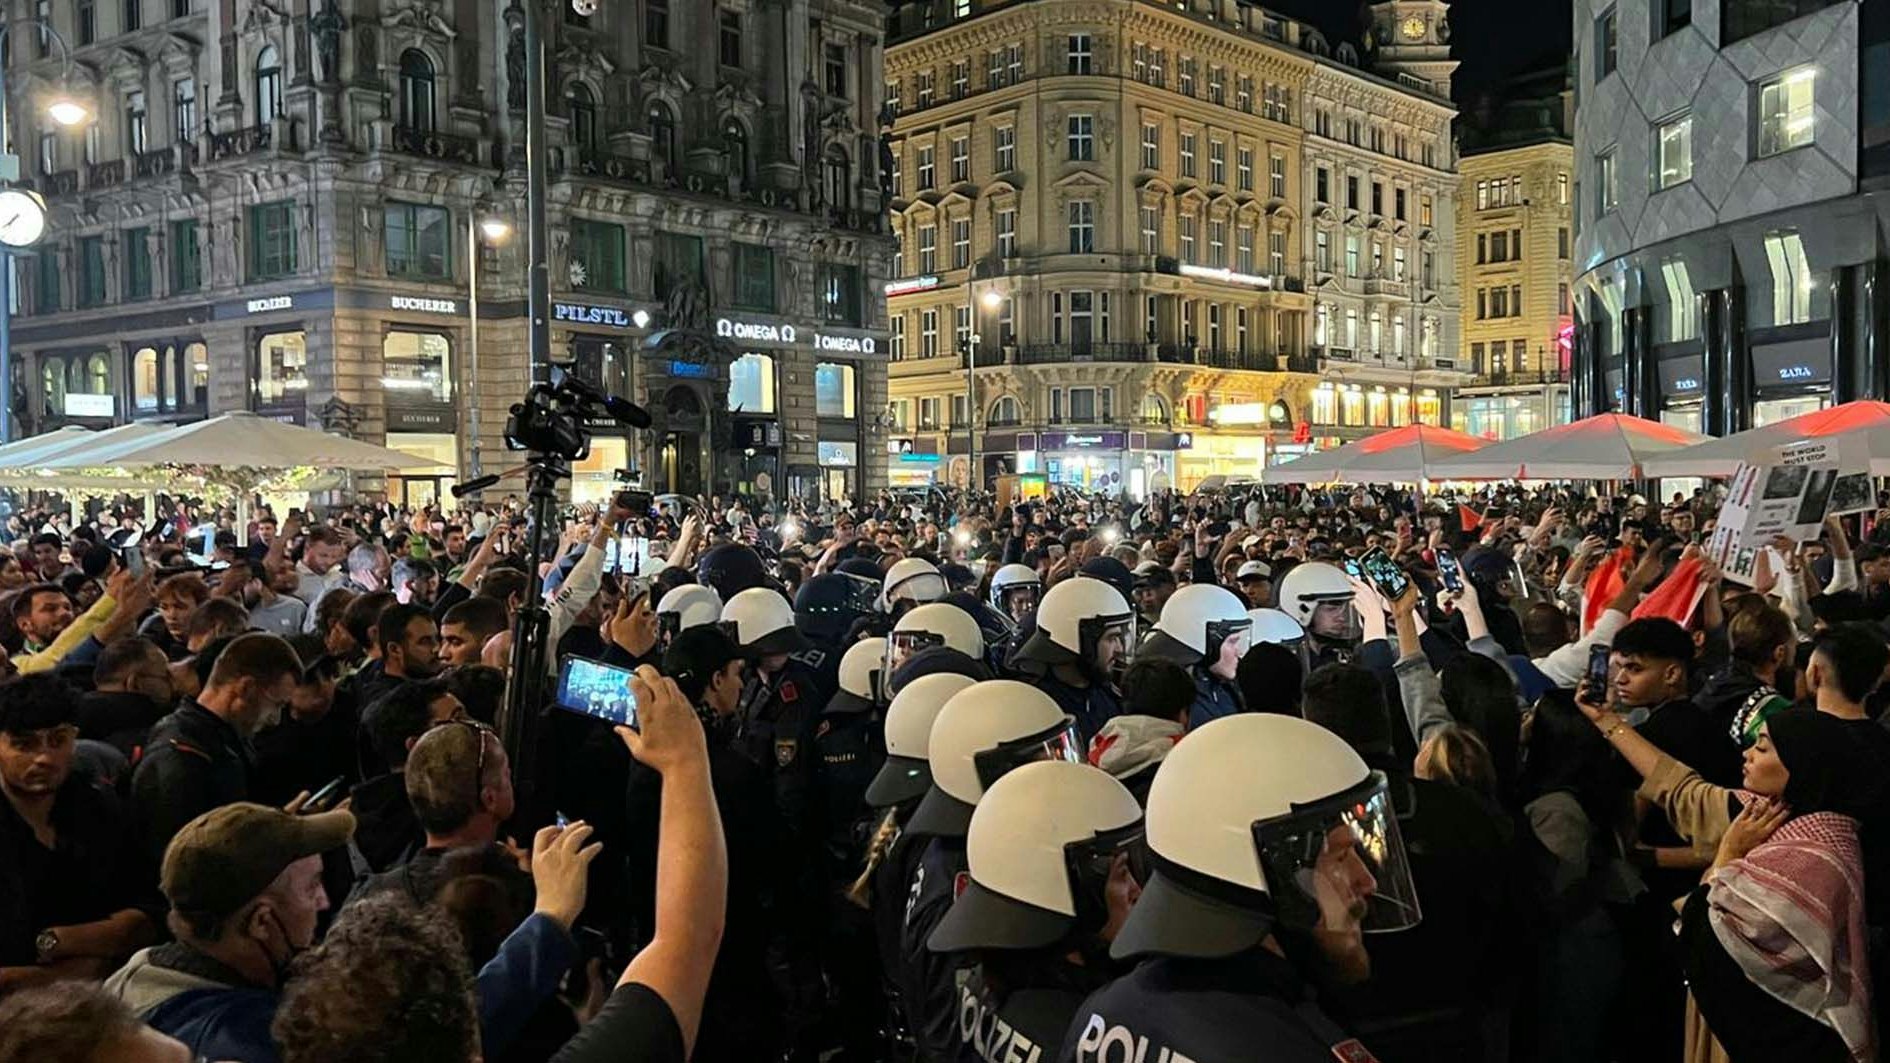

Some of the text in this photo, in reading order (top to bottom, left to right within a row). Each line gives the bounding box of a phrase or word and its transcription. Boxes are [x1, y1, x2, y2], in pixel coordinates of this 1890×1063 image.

[391, 296, 455, 313] BUCHERER
[555, 304, 628, 326] PILSTL
[734, 323, 779, 341] OMEGA
[821, 335, 861, 353] OMEGA
[1779, 367, 1812, 379] ZARA
[1797, 445, 1826, 455] WORLD
[1806, 453, 1826, 461] STOP
